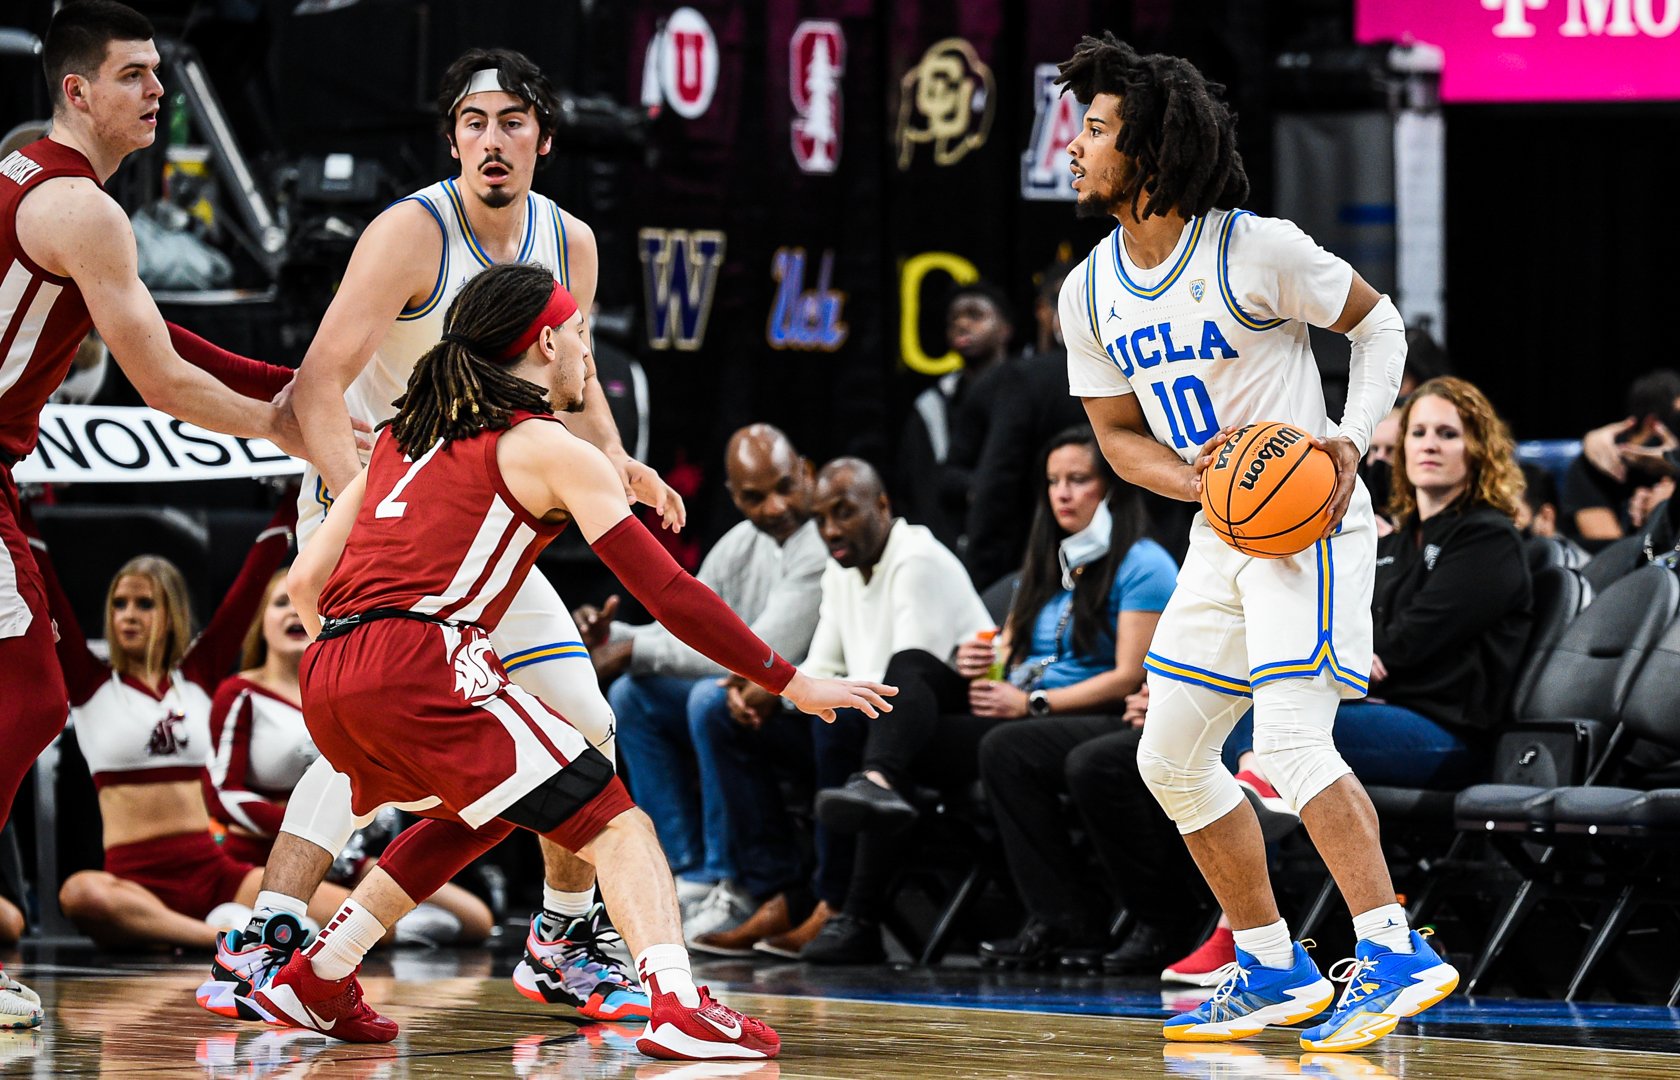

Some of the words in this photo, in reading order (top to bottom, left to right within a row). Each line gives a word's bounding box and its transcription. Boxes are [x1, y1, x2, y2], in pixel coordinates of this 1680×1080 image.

[638, 227, 727, 350] W
[1105, 320, 1240, 379] UCLA
[1150, 374, 1221, 449] 10
[1238, 426, 1305, 491] Wilson
